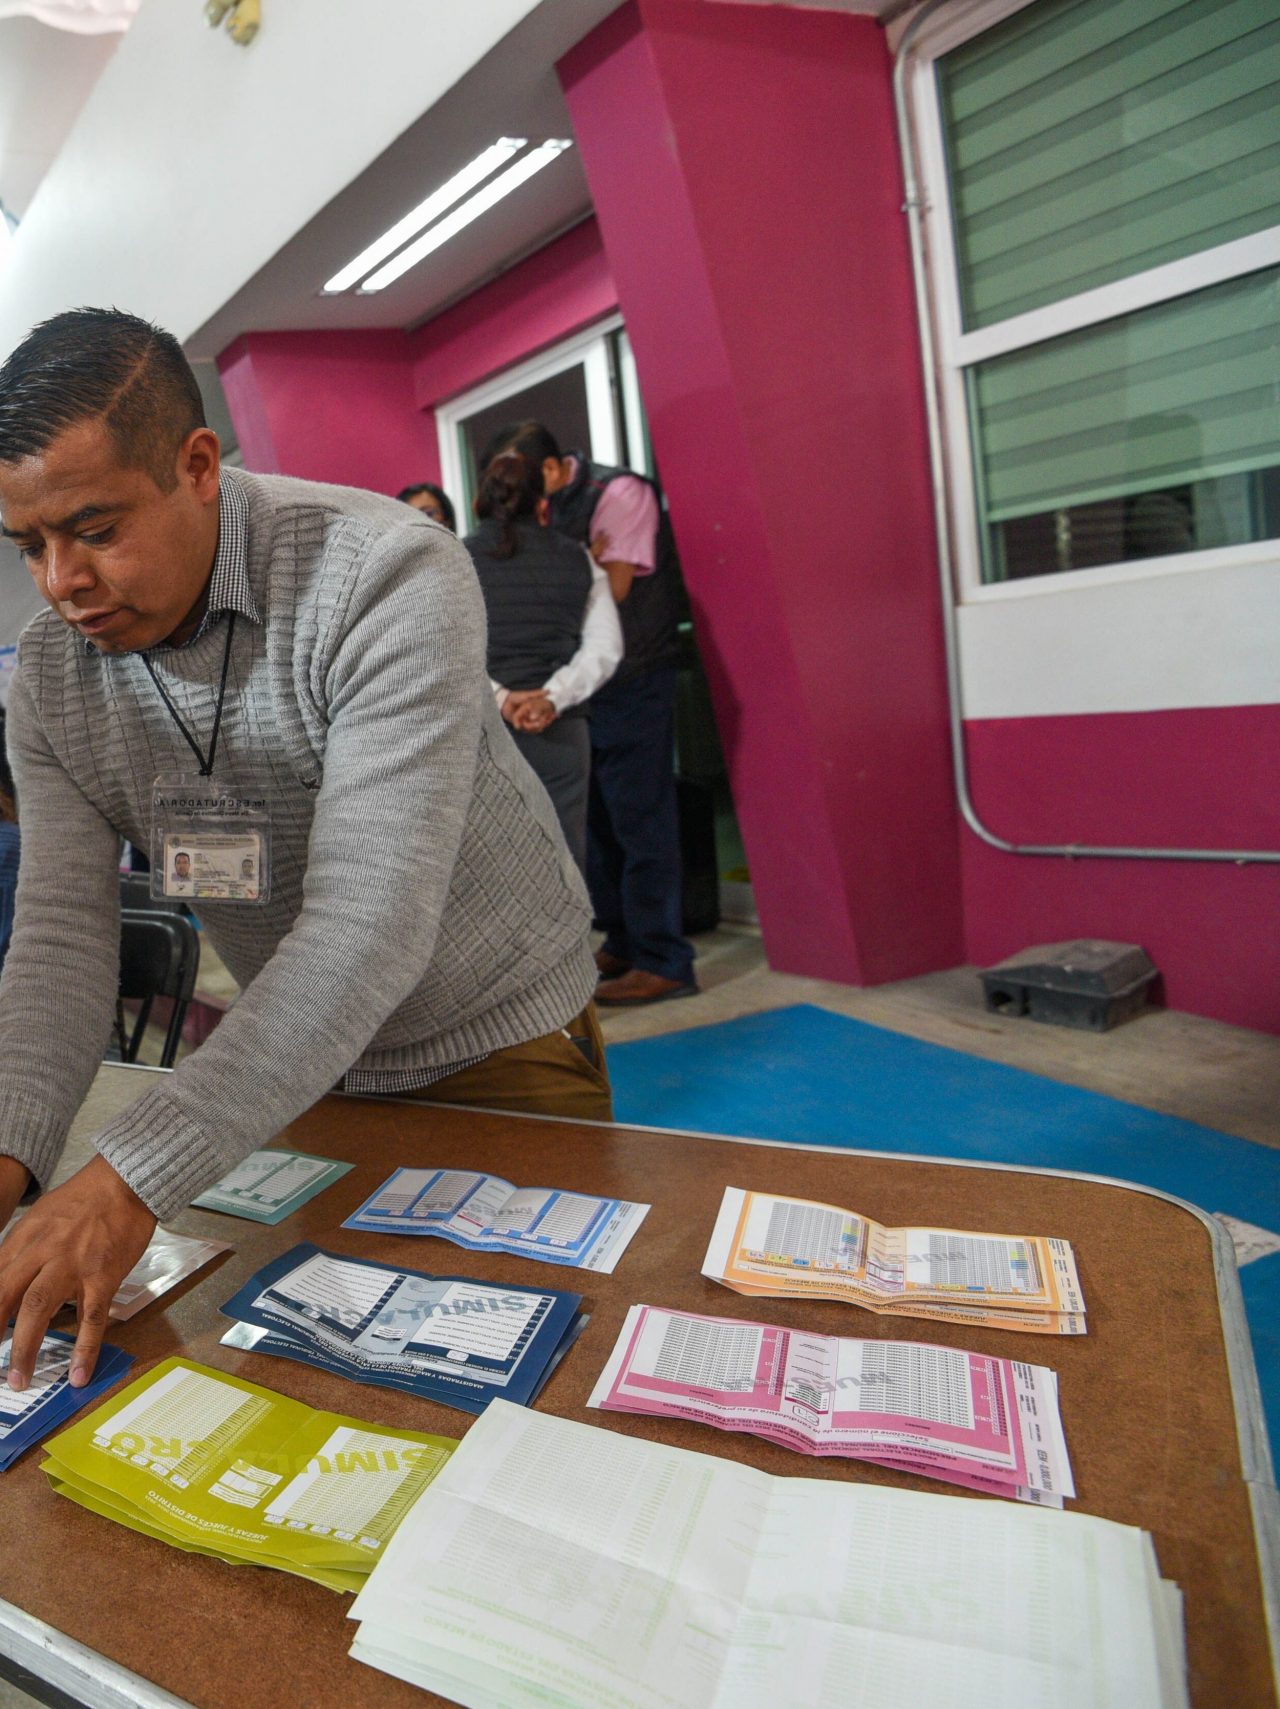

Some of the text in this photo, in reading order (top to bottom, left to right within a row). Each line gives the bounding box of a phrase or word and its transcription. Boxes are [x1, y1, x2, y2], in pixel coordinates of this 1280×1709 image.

[261, 1312, 291, 1327] ELECTORAL
[388, 1365, 431, 1377] MAGISTRADOS
[439, 1375, 485, 1389] MAGISTRADAS
[689, 1398, 737, 1411] preferencia
[703, 1411, 736, 1423] ESTADO
[760, 1409, 812, 1429] candidatura
[880, 1431, 929, 1442] Seleccione
[900, 1446, 957, 1461] PRESIDENCIA
[148, 1490, 186, 1516] DISTRITO
[185, 1512, 198, 1522] DE
[198, 1518, 229, 1530] JUECES
[236, 1529, 269, 1541] JUEZAS
